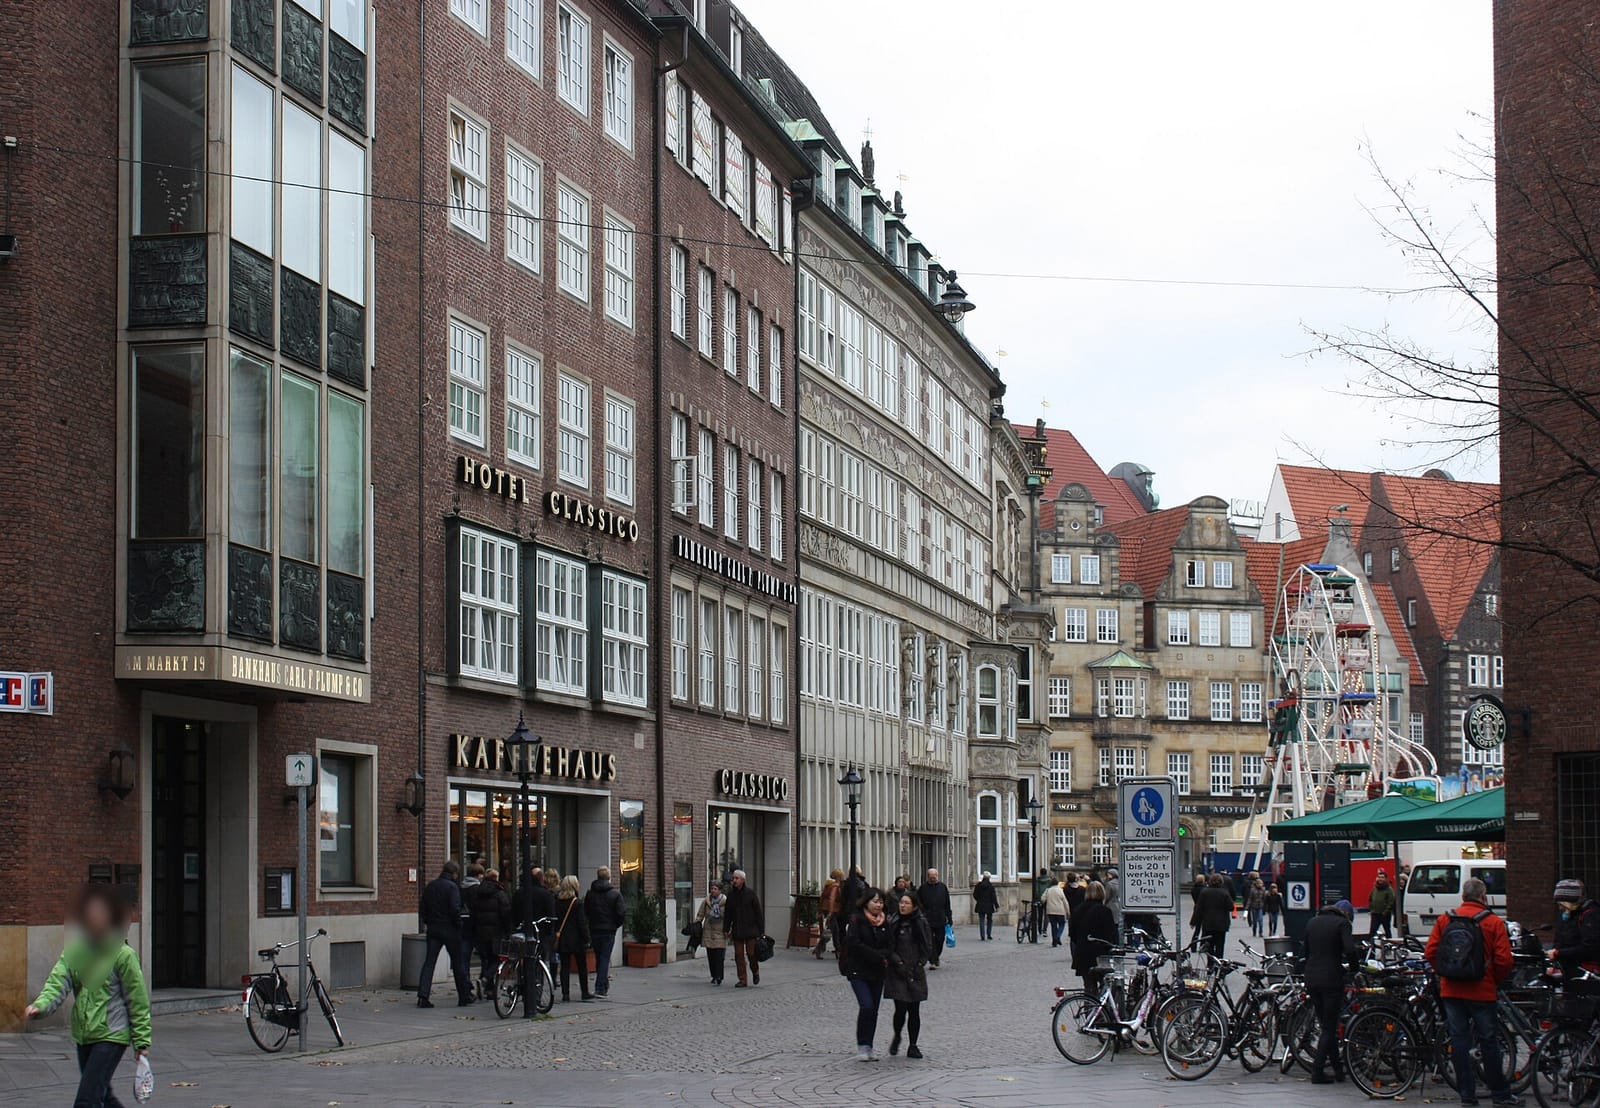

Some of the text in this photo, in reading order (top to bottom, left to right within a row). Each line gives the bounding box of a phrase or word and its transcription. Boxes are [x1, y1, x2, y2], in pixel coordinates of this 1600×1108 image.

[463, 456, 639, 542] HOTEL CLASSICO
[125, 655, 205, 671] AM MARKT 19
[231, 655, 281, 684] BANKHAUS
[284, 664, 306, 689] CARL
[315, 670, 343, 694] PLUMP
[345, 675, 350, 695] &
[1471, 705, 1504, 725] STARBUCKS
[1476, 735, 1500, 747] COFFEE
[455, 734, 617, 781] KAFFEEHAUS
[721, 768, 789, 801] CLASSICO
[1178, 805, 1198, 813] THS
[1135, 828, 1160, 837] ZONE
[1128, 862, 1142, 870] bis
[1126, 871, 1170, 879] werktags
[1130, 879, 1154, 887] 20-11
